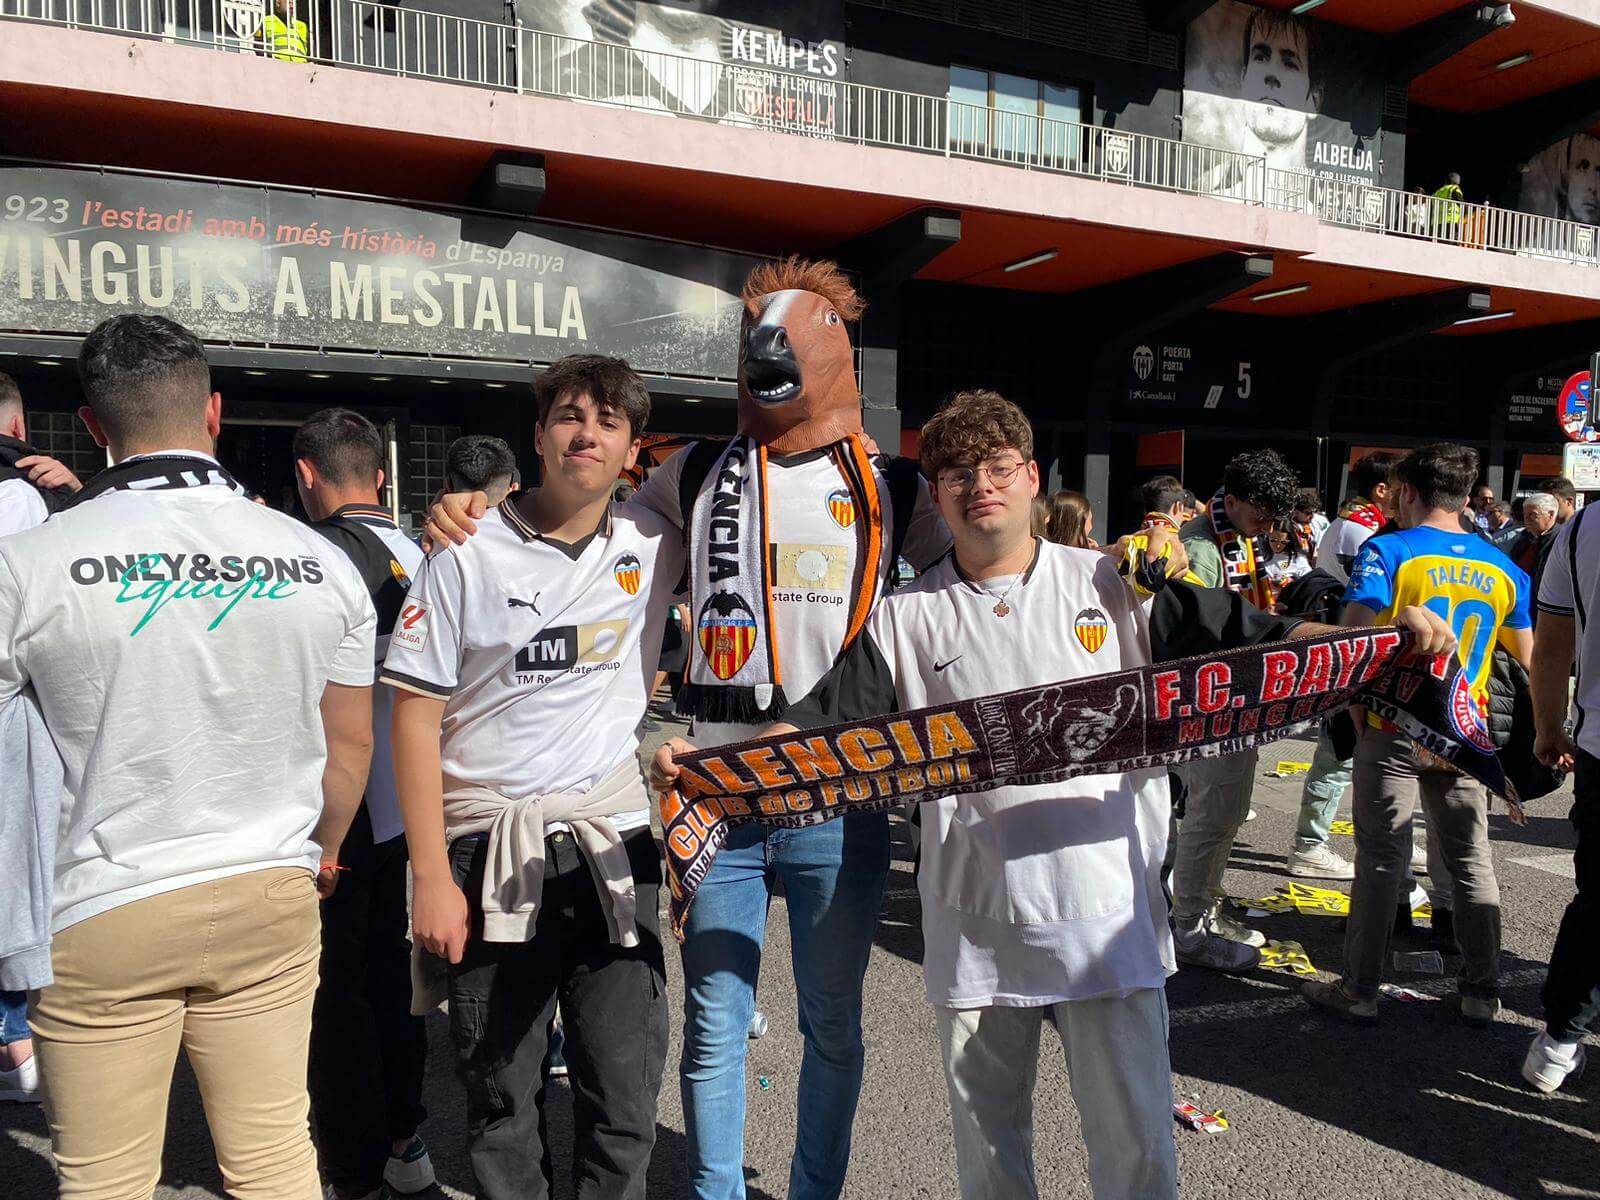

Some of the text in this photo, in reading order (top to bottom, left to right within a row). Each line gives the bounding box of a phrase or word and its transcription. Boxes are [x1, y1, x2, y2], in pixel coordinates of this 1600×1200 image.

[732, 27, 837, 76] KEMPES
[1313, 141, 1374, 172] ALBELDA
[4, 194, 566, 276] 923 l'estadi amb més història d'Espanya
[272, 256, 309, 318] A
[330, 261, 588, 341] MESTALLA
[1163, 346, 1191, 359] PUERTA
[1237, 362, 1251, 399] 5
[69, 552, 325, 586] ONLY&SONS
[1426, 562, 1496, 595] TALÉNS
[771, 591, 844, 605] state Group
[527, 638, 567, 663] TM
[516, 674, 534, 685] TM
[537, 674, 553, 685] Re
[1154, 662, 1245, 721] F.C.
[668, 797, 752, 860] CLUB
[820, 758, 978, 808] FUTBOL
